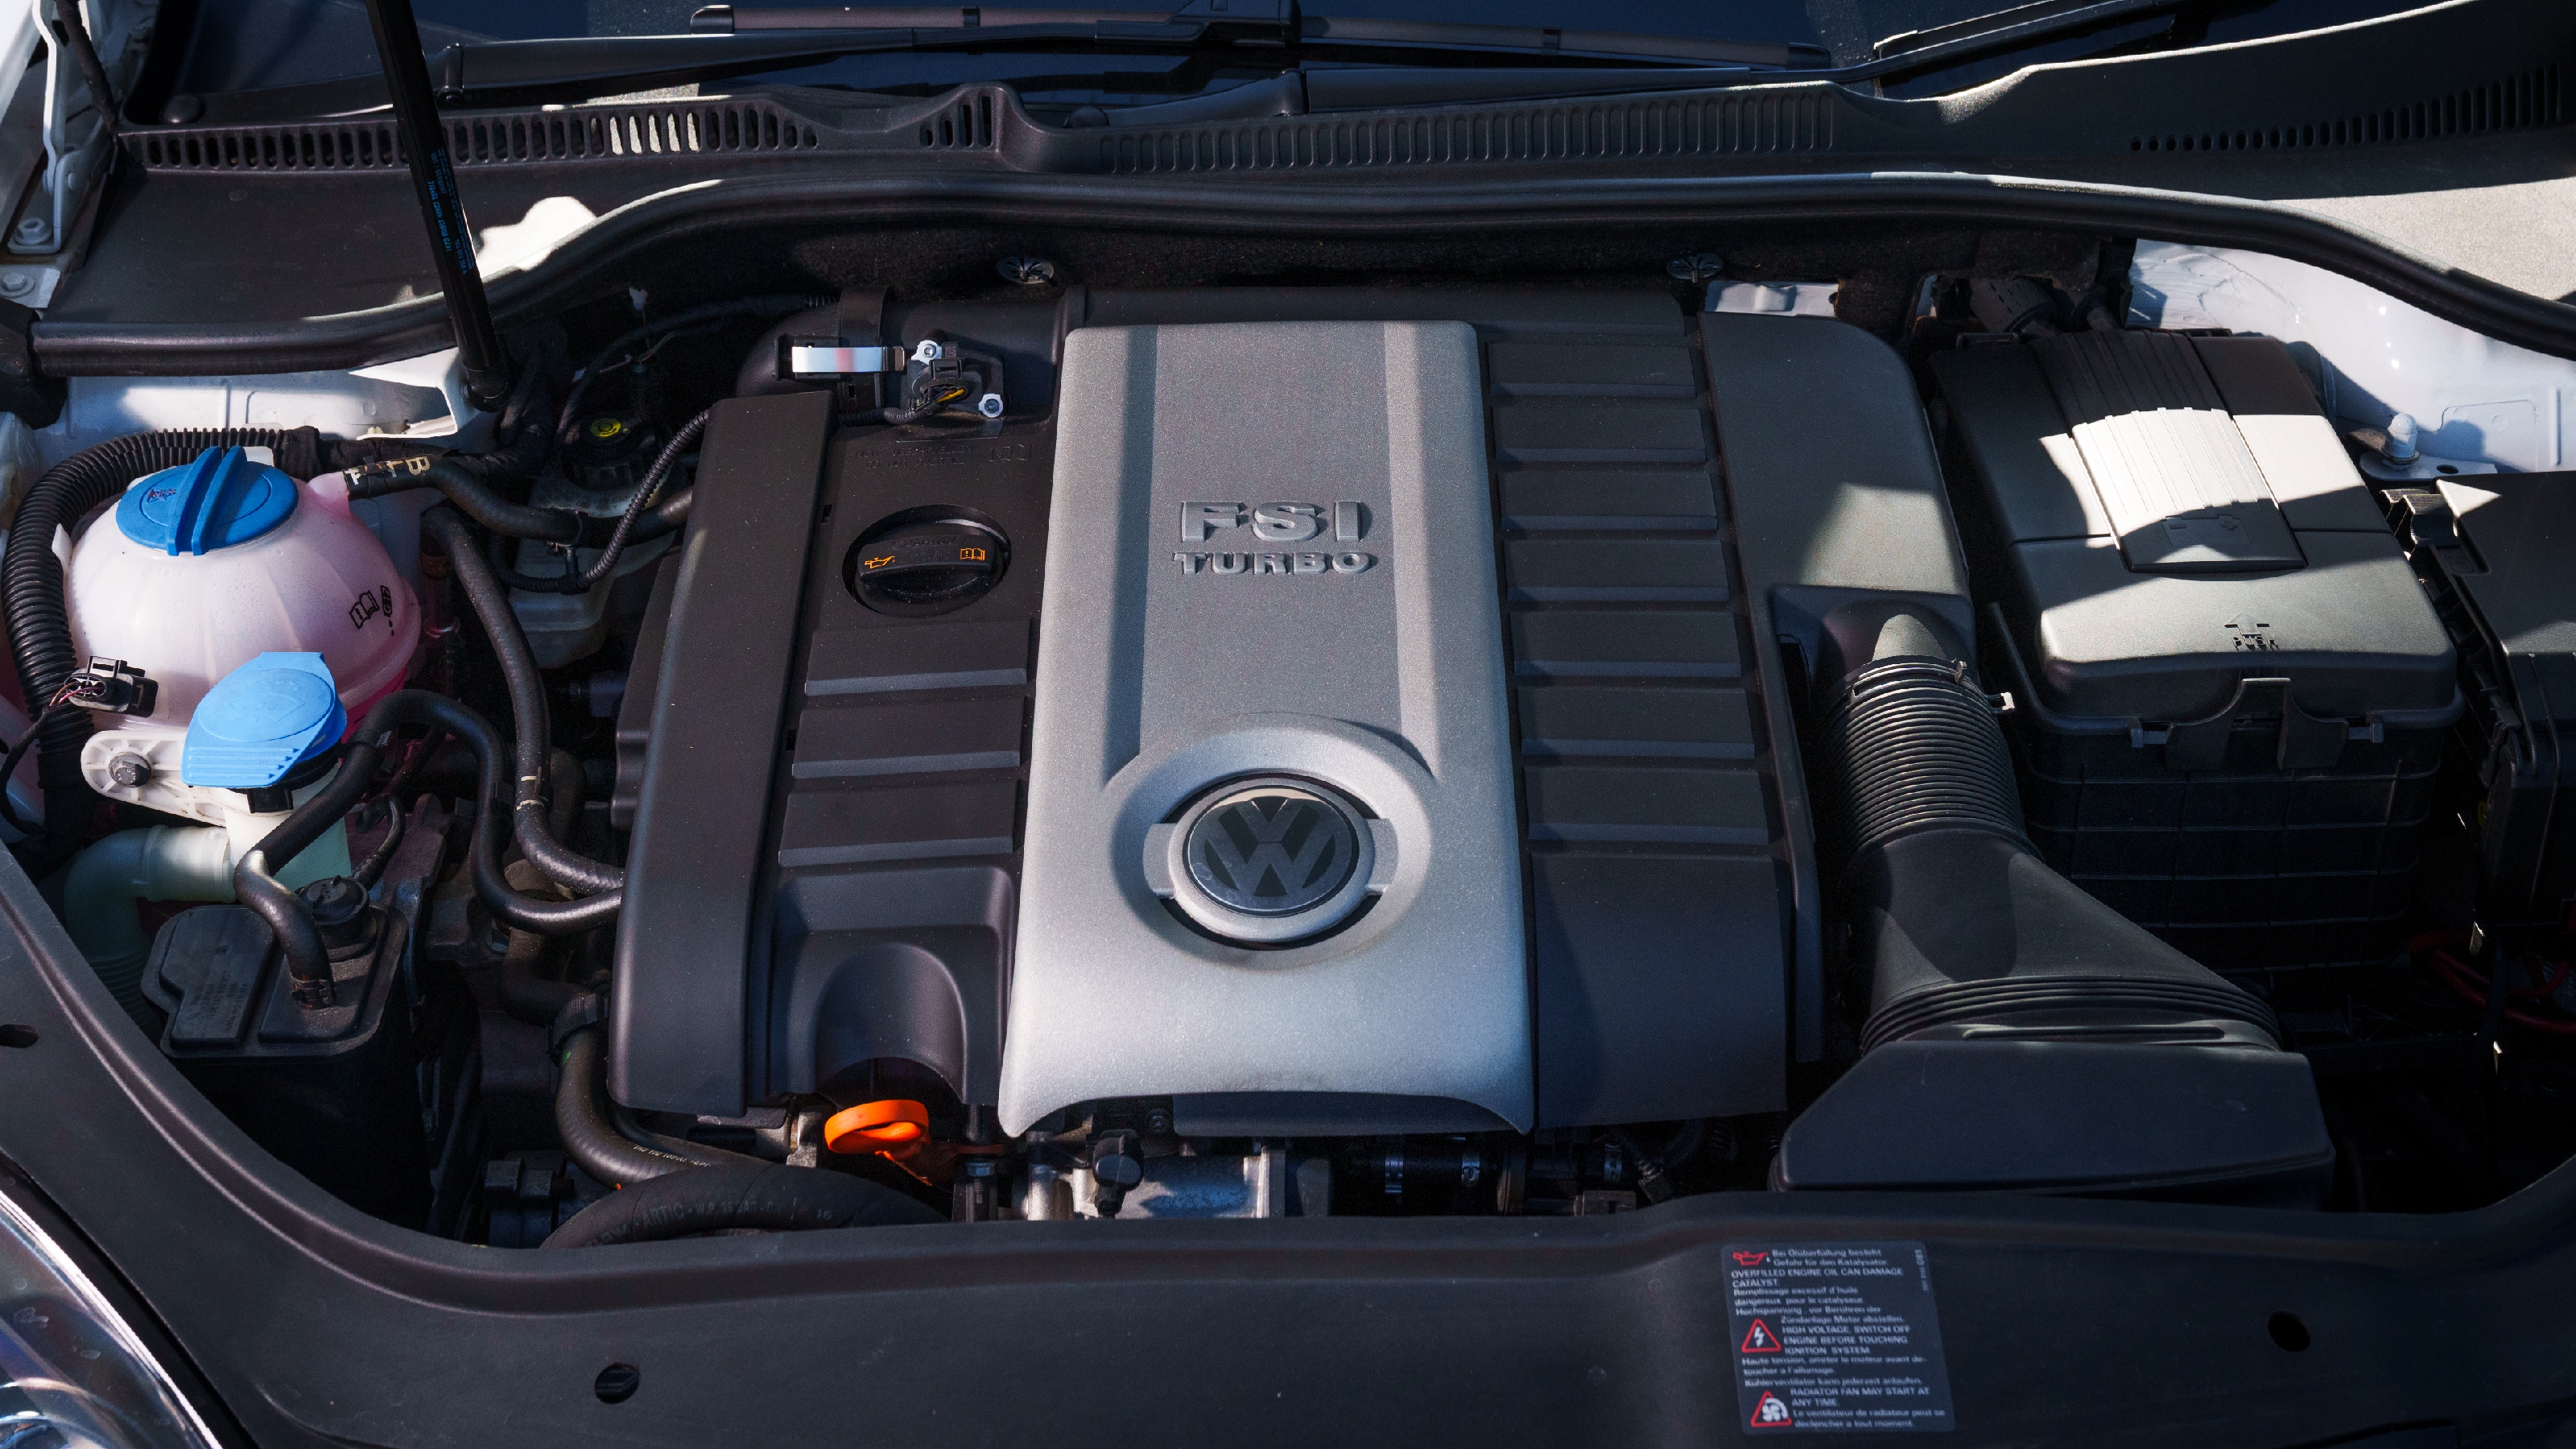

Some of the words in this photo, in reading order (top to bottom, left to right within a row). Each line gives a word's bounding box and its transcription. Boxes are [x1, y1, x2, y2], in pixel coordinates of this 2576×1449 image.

[1181, 500, 1368, 543] FSI
[1173, 551, 1373, 575] TURBO
[2231, 634, 2279, 651] PUSH
[1190, 792, 1354, 911] VW
[1772, 1249, 1786, 1257] Bei
[1848, 1249, 1881, 1257] besteht
[1773, 1258, 1802, 1266] Gefahr
[1805, 1257, 1817, 1266] für
[1819, 1258, 1835, 1266] den
[1731, 1269, 1785, 1278] OVERFILLED
[1787, 1268, 1821, 1277] ENGINE
[1823, 1268, 1838, 1276] OIL
[1841, 1267, 1861, 1276] CAN
[1862, 1267, 1903, 1276] DAMAGE
[1733, 1288, 1789, 1297] Remplissage
[1791, 1286, 1827, 1295] excessif
[1734, 1298, 1781, 1307] dangereux
[1808, 1296, 1816, 1304] le
[1781, 1315, 1832, 1324] Zündanlage
[1834, 1315, 1860, 1323] Motor
[1781, 1326, 1806, 1334] HIGH
[1854, 1324, 1891, 1333] SWITCH
[1893, 1324, 1910, 1333] OFF
[1783, 1336, 1818, 1345] ENGINE
[1820, 1335, 1856, 1344] BEFORE
[1859, 1335, 1908, 1344] TOUCHING
[1785, 1346, 1827, 1355] IGNITION
[1741, 1357, 1769, 1365] Haute
[1912, 1355, 1923, 1363] de
[1743, 1368, 1777, 1376] toucher
[1818, 1377, 1840, 1385] kann
[1790, 1387, 1839, 1396] RADIATOR
[1840, 1386, 1860, 1395] FAN
[1861, 1386, 1883, 1395] MAY
[1885, 1386, 1915, 1395] START
[1918, 1386, 1930, 1395] AT
[1791, 1397, 1811, 1406] ANY
[1806, 1409, 1853, 1417] ventilateur
[1869, 1409, 1909, 1417] radiateur
[1911, 1409, 1932, 1418] peut
[1854, 1420, 1872, 1428] tout
